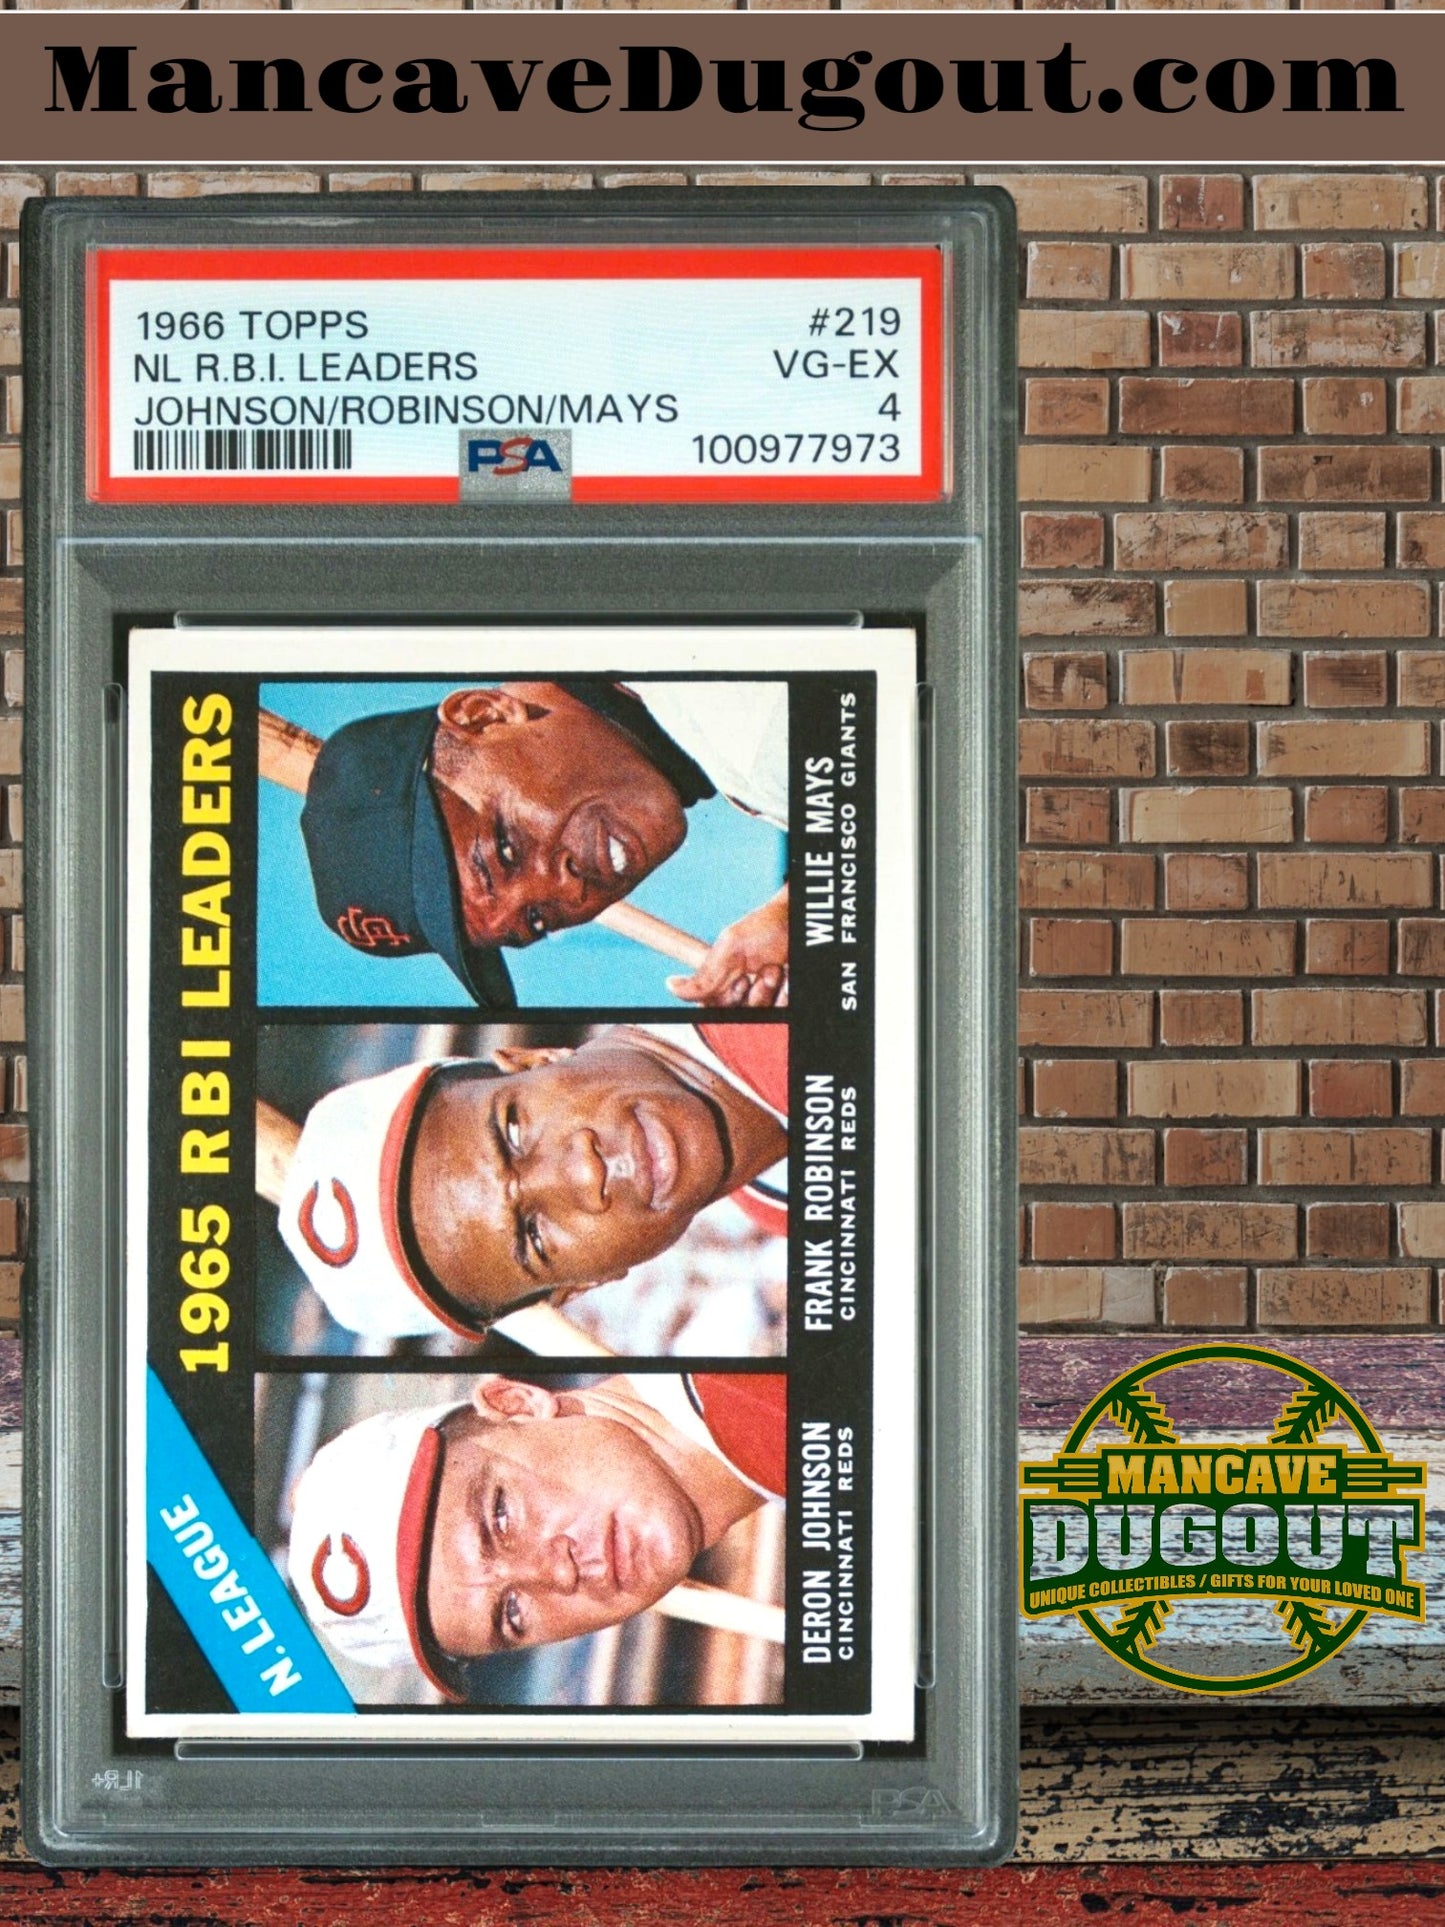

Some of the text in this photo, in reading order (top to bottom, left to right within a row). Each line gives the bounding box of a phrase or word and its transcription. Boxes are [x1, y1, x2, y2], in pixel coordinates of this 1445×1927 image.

[136, 310, 369, 340] 1966 TOPPS
[808, 307, 902, 337] #219
[134, 352, 478, 383] NL R.B.I. LEADERS
[772, 349, 900, 380] VG-EX
[134, 393, 679, 427] JOHNSON/ROBINSON/MAYS
[877, 393, 901, 422] 4
[467, 436, 563, 475] PSA
[691, 434, 901, 465] 100977973
[805, 756, 835, 947] WILLIE MAYS
[840, 692, 857, 1011] SAN FRANCISCO GIANTS
[179, 693, 233, 1374] 1965 RBI LEADERS
[804, 1074, 834, 1331] FRANK ROBINSON
[840, 1086, 857, 1321] CINCINNATI REDS
[801, 1421, 832, 1664] DERON JOHNSON
[838, 1426, 854, 1661] CINCINNATI REDS
